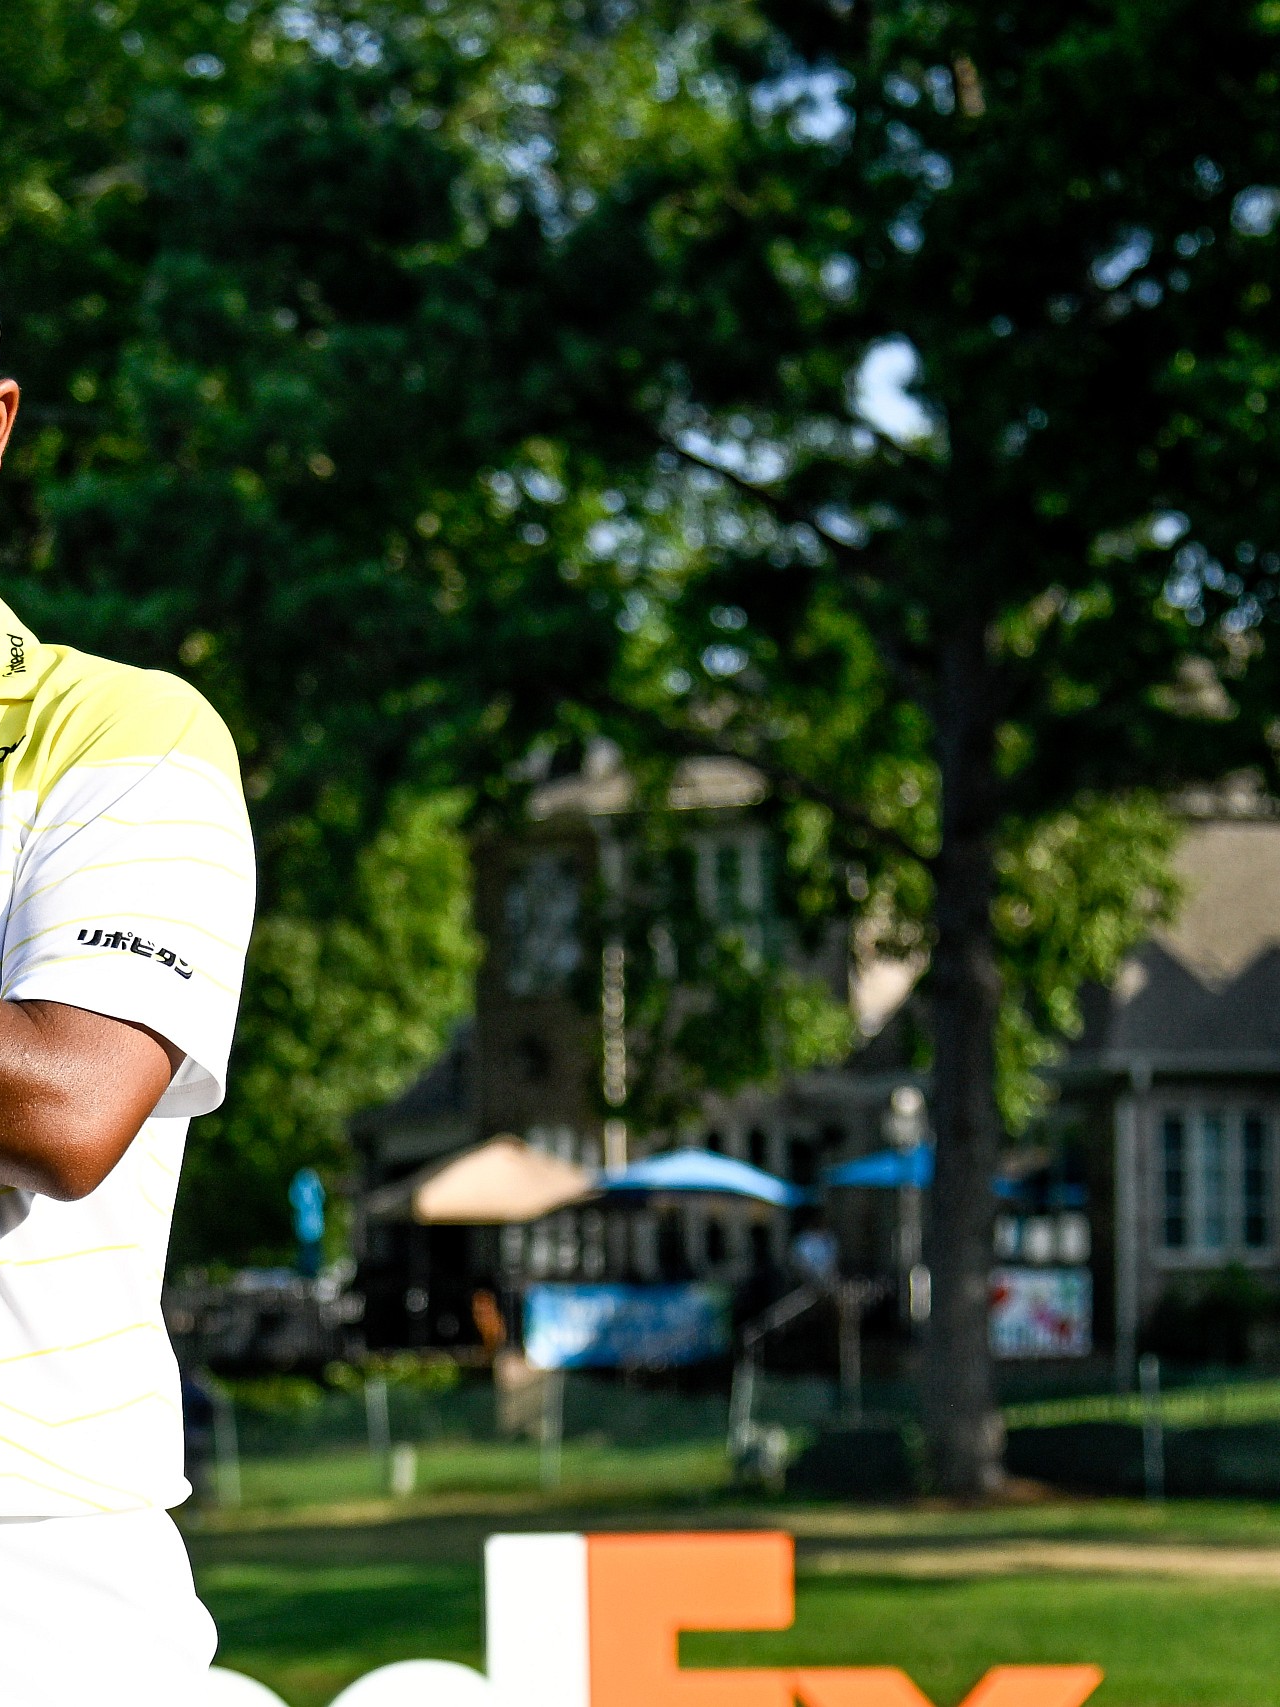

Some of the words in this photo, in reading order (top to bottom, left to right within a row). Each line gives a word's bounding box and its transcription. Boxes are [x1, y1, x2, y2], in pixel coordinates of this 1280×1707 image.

[77, 929, 193, 979] リポビタン
